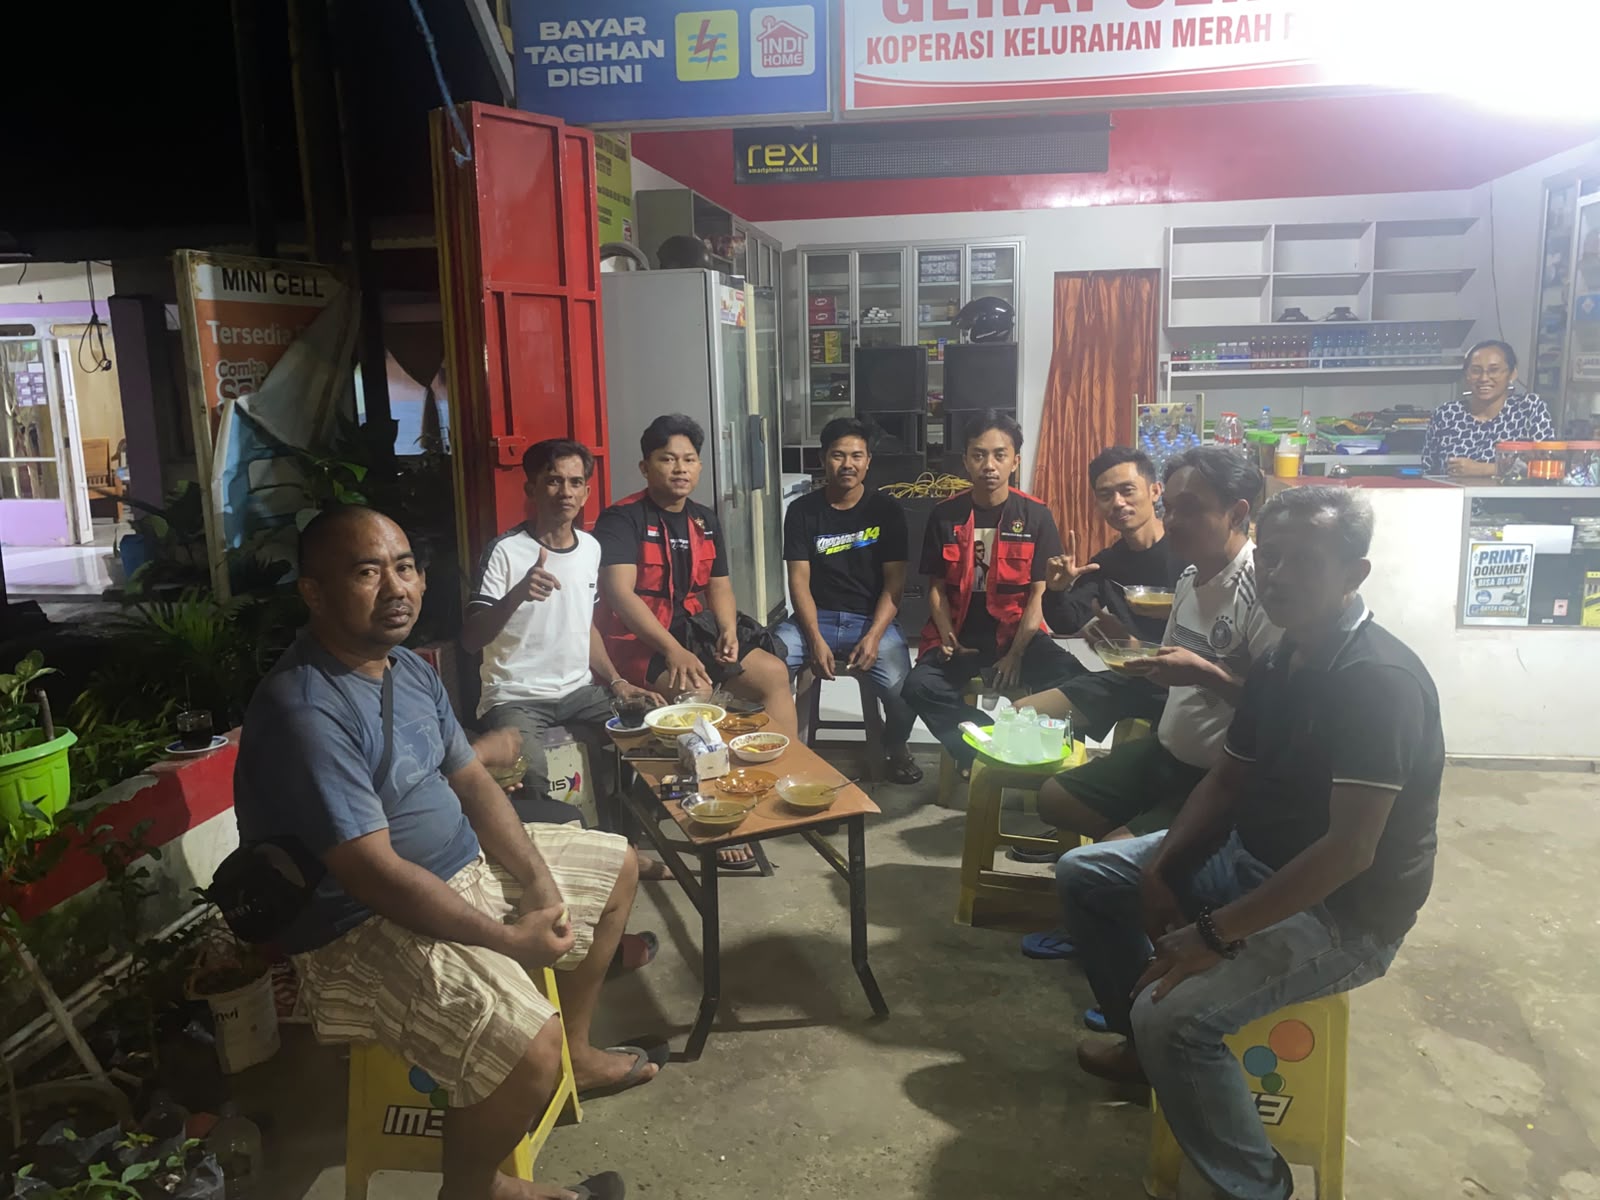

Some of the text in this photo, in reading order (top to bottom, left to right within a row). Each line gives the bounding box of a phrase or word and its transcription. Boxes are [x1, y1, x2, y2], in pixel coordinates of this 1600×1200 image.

[540, 16, 646, 41] BAYAR
[866, 30, 994, 65] KOPERASI
[1004, 19, 1162, 57] KELURAHAN
[1172, 13, 1272, 48] MERAH
[524, 39, 665, 65] TAGIHAN
[763, 36, 803, 55] INDI
[763, 53, 803, 67] HOME
[548, 64, 642, 88] DISINI
[747, 135, 818, 167] rexi
[748, 166, 784, 175] smartphone
[222, 268, 325, 298] MINI CELL
[1478, 549, 1525, 564] PRINT
[1474, 564, 1527, 576] DOKUMEN
[1479, 576, 1521, 586] BISA DI SINI
